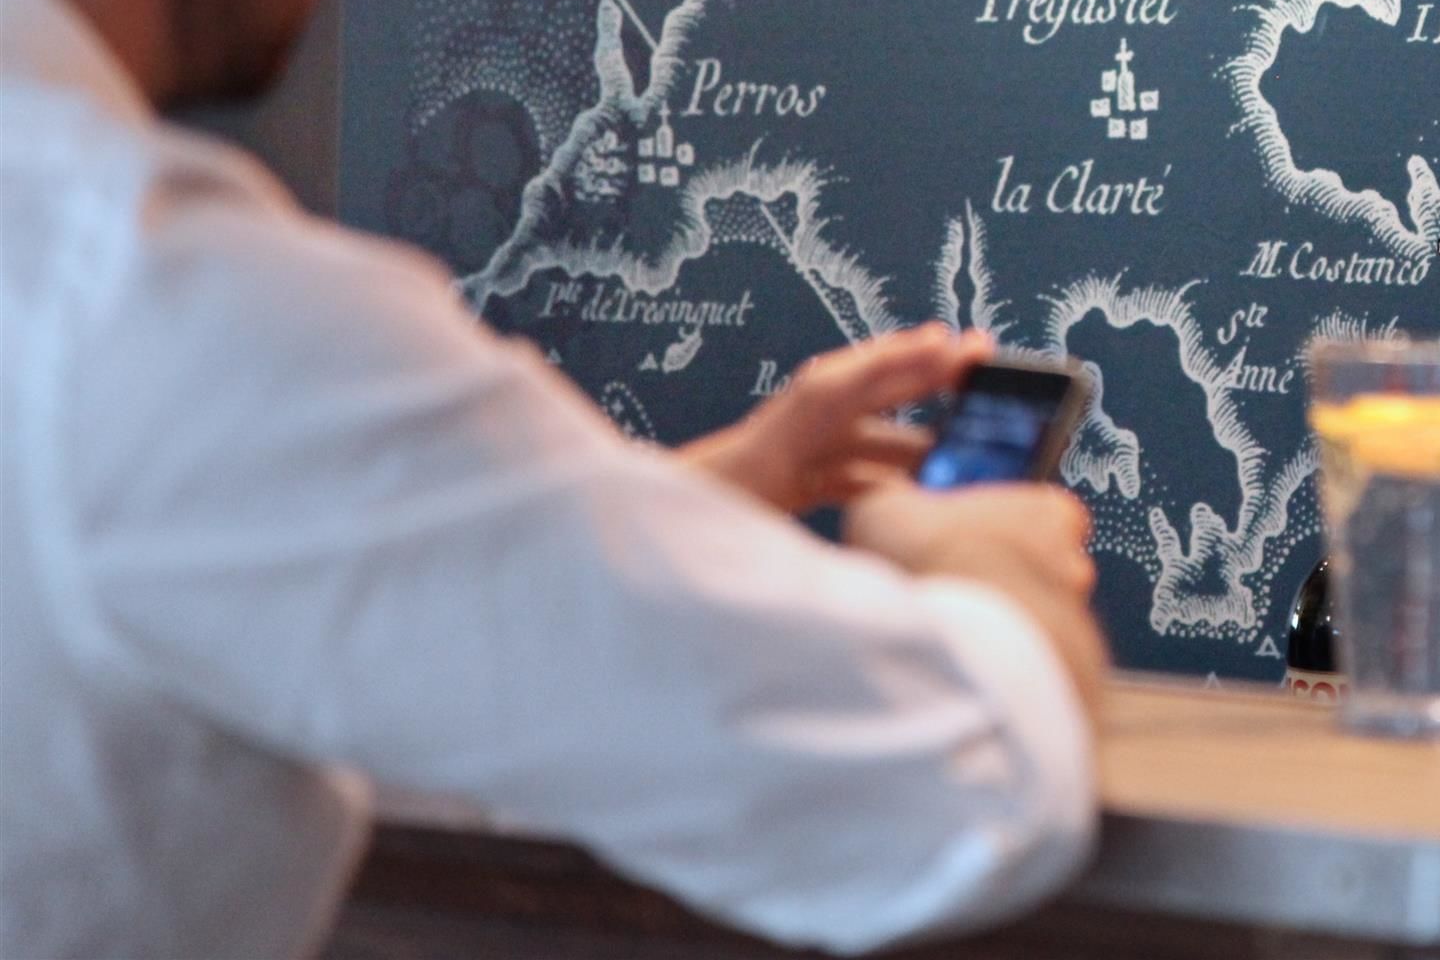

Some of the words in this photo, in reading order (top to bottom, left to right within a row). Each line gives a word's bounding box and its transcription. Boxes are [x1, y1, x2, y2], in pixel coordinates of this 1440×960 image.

[680, 58, 826, 117] Perros
[991, 155, 1032, 212] la
[1046, 158, 1173, 215] Clarté
